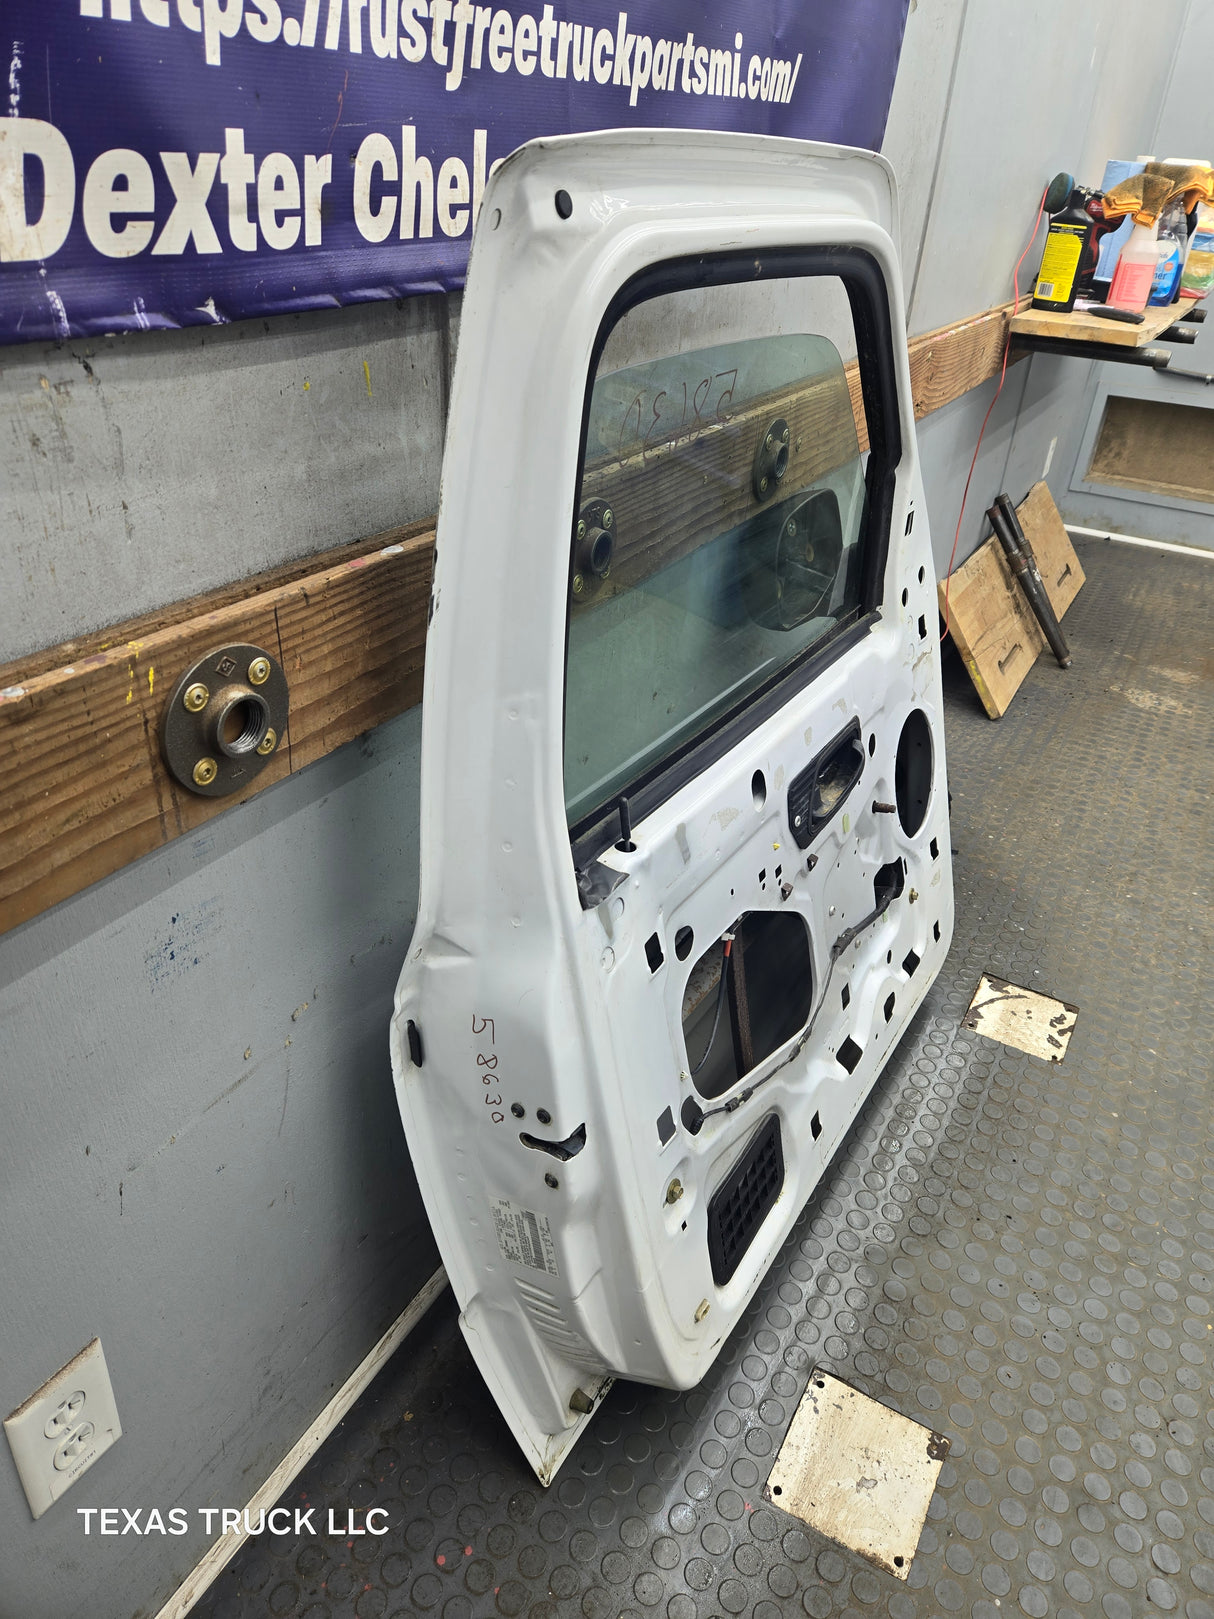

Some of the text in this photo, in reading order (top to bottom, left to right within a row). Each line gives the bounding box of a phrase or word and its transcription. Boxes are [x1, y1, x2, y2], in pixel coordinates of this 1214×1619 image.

[79, 0, 803, 106] ps//rustfreetruckpartsmi.com/
[0, 117, 507, 262] Dexter Chel
[471, 1013, 505, 1124] 58630
